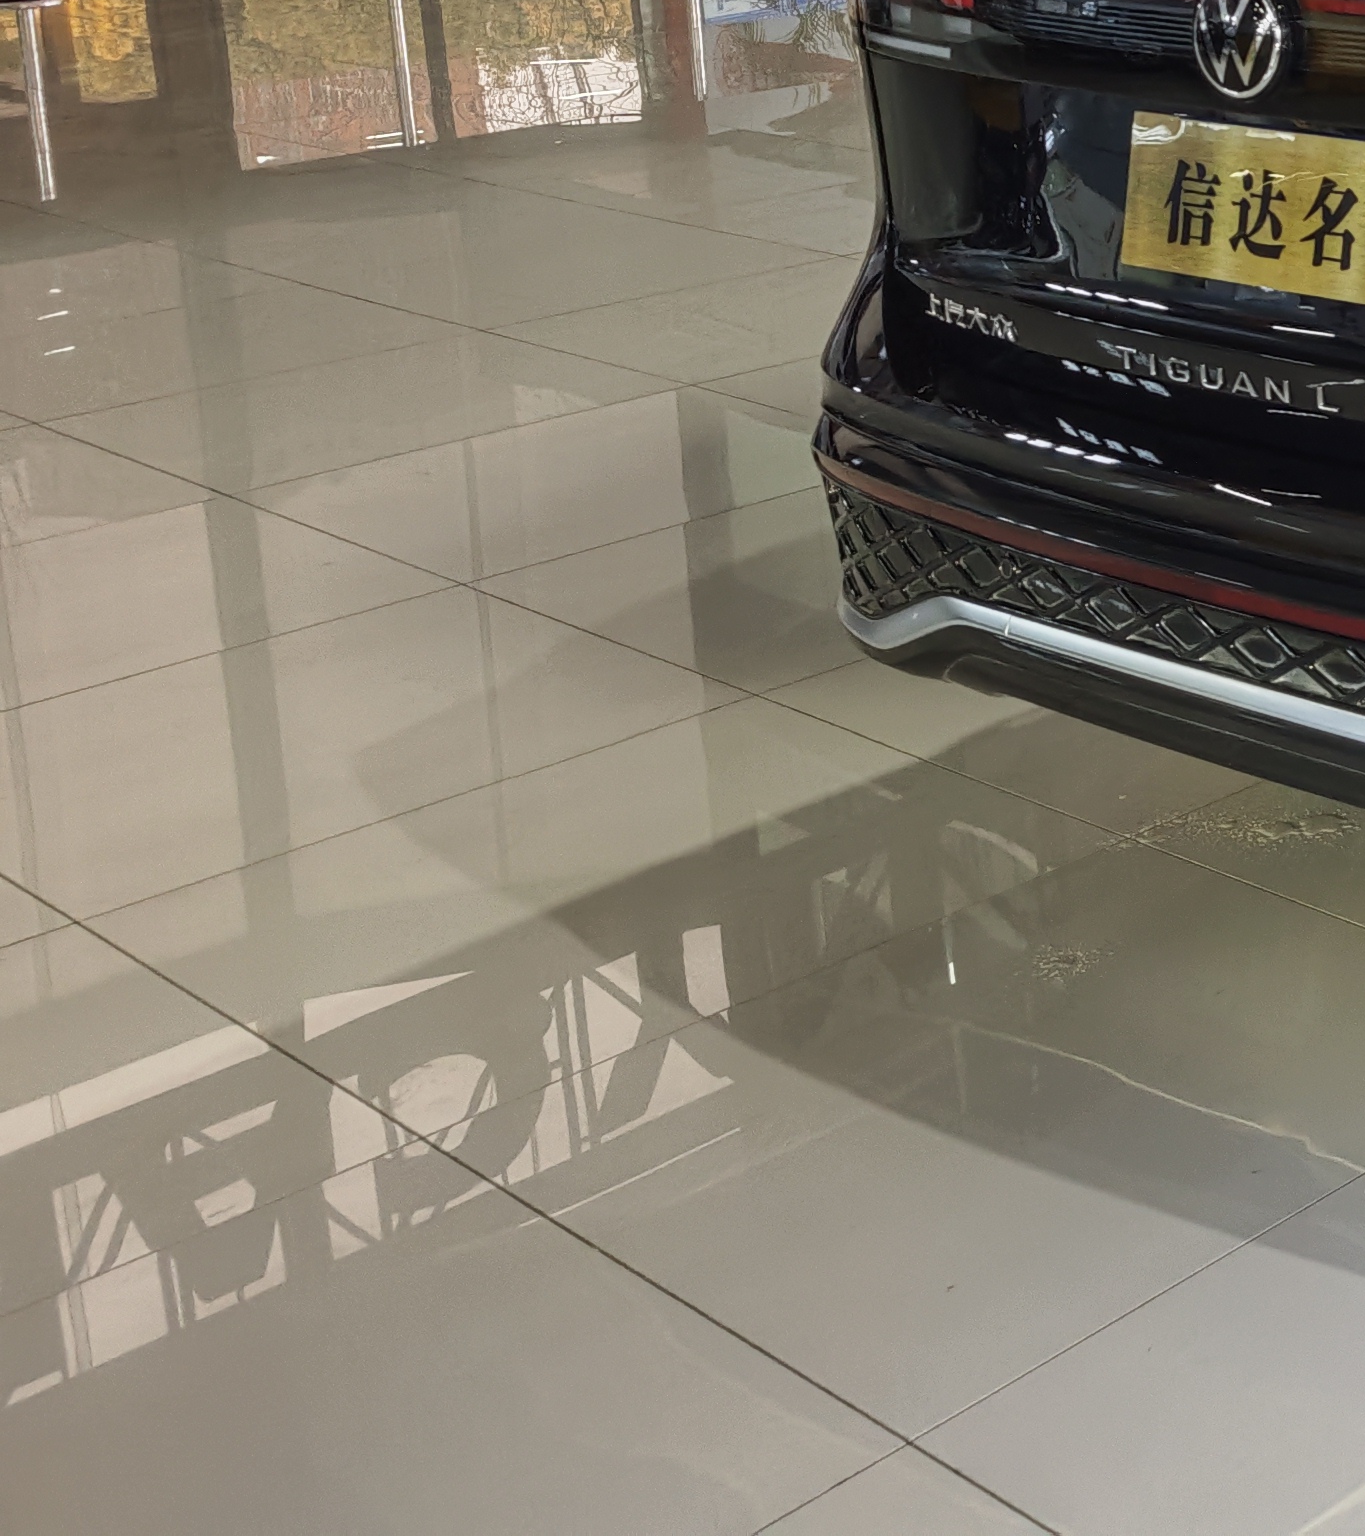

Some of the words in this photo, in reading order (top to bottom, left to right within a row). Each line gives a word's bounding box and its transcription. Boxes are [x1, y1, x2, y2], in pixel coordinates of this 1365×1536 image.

[924, 292, 1018, 343] 上汽大众
[1116, 344, 1290, 405] TIGUAN
